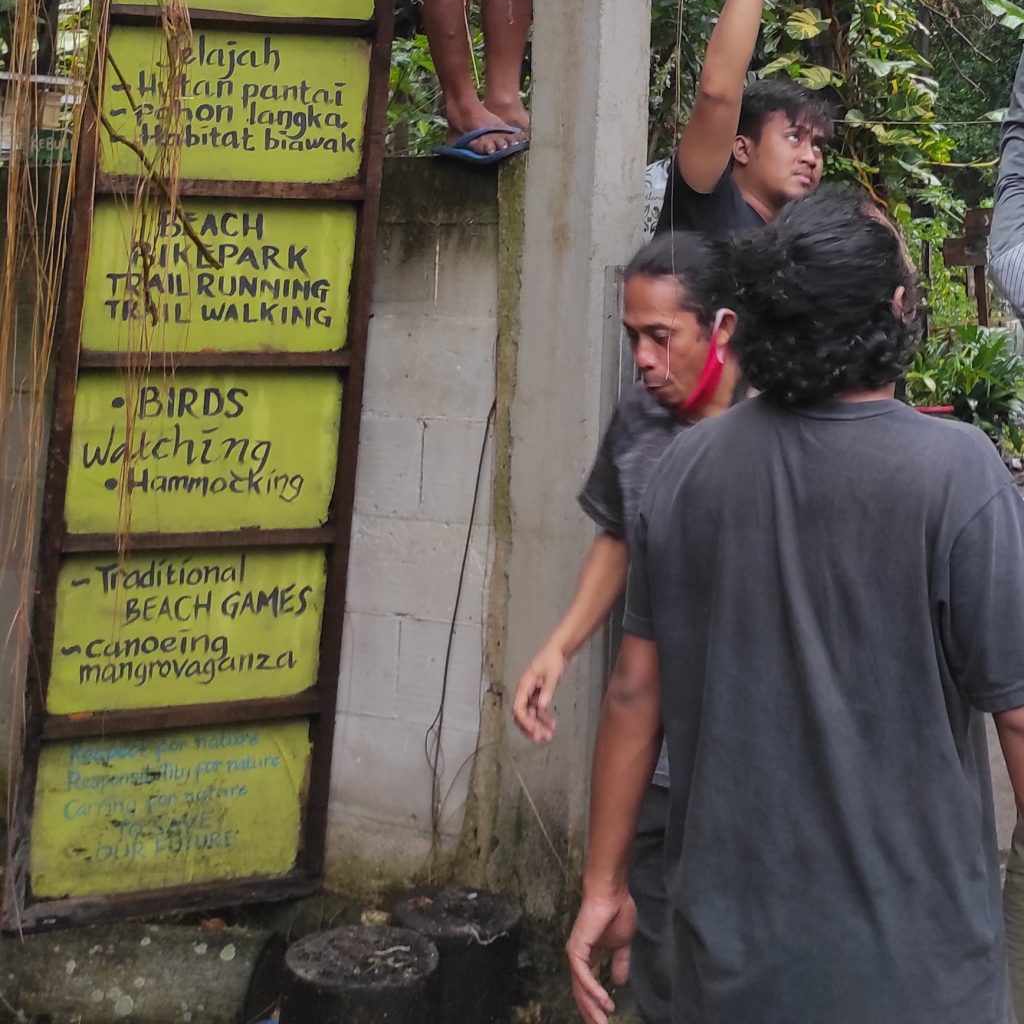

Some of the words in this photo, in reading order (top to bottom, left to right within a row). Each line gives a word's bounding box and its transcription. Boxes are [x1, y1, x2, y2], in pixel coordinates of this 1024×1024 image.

[241, 79, 347, 110] pantai
[264, 127, 356, 154] biawak
[159, 209, 264, 240] BEACH
[196, 272, 331, 303] RUNNING
[201, 301, 333, 328] WALKING
[139, 386, 249, 420] BIRDS
[128, 469, 304, 503] Hammocking
[96, 553, 246, 593] Traditional
[123, 590, 213, 626] BEACH
[220, 584, 313, 619] GAMES
